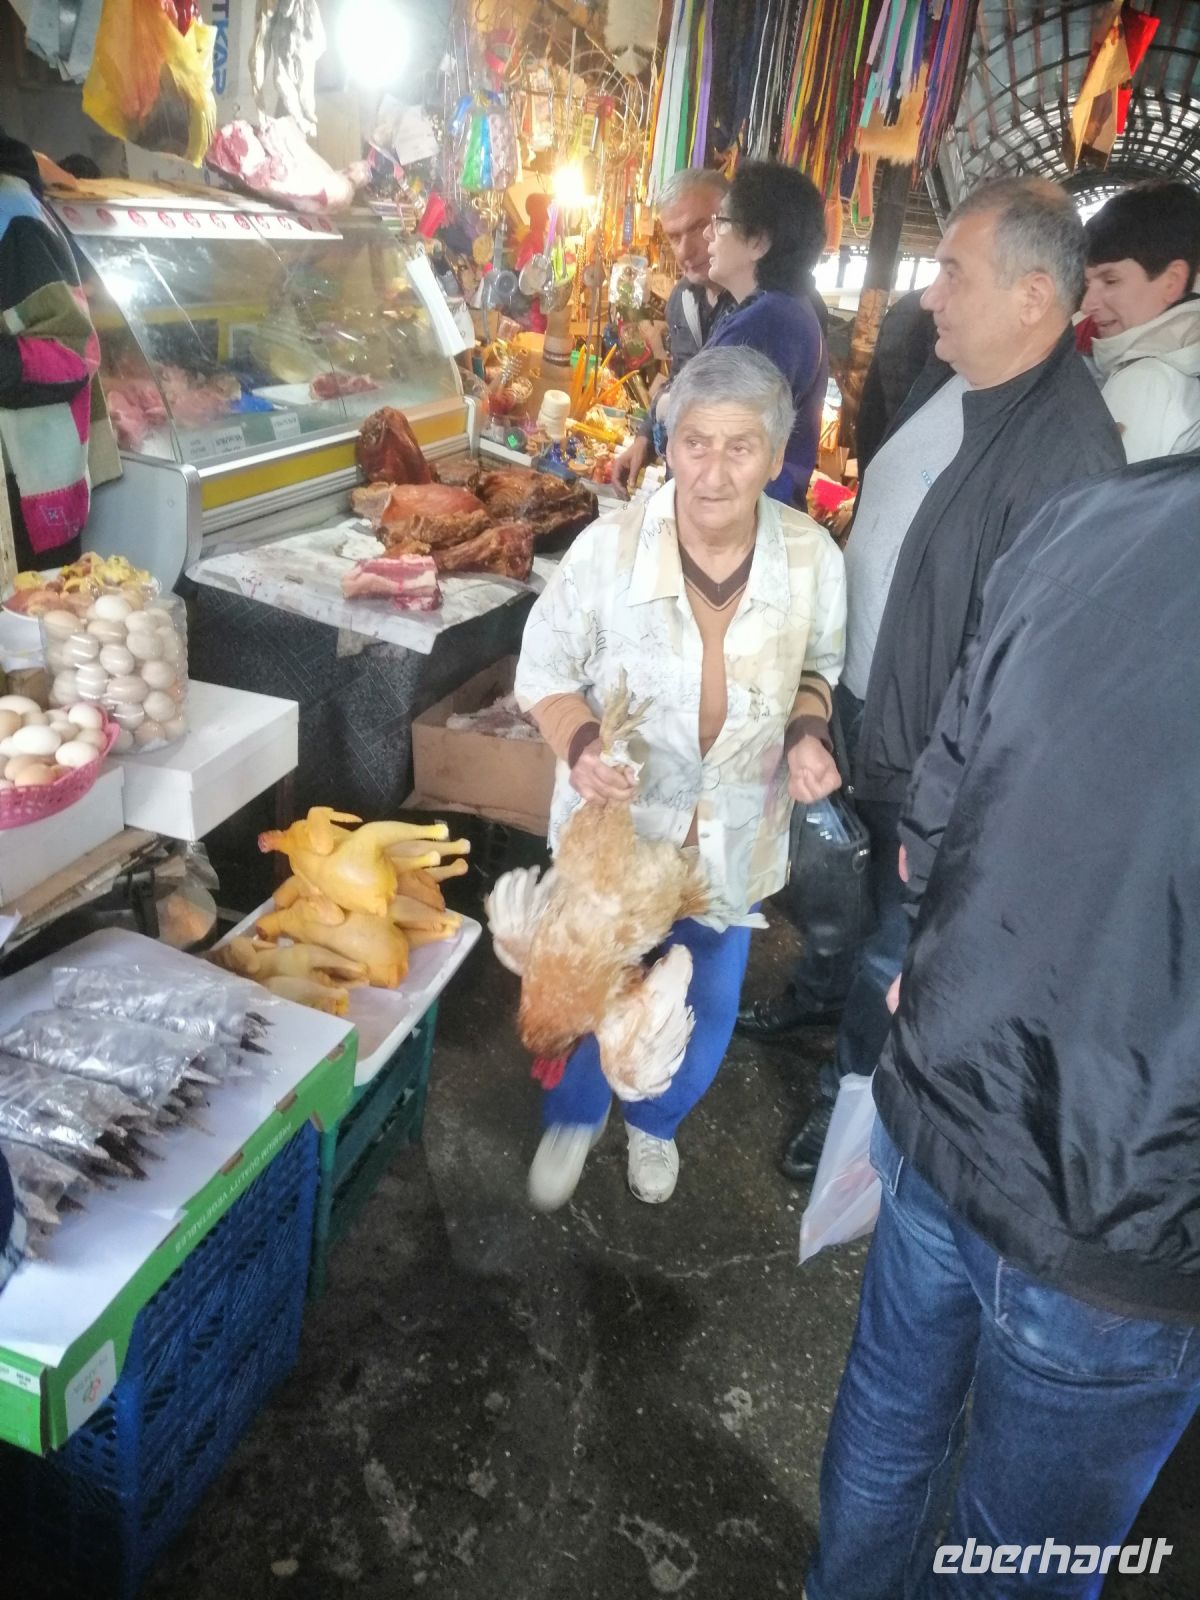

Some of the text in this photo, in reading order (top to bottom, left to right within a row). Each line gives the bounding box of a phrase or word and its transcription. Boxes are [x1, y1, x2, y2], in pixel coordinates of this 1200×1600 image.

[175, 1121, 292, 1254] PREMIUM QUALITY VEGETABLES
